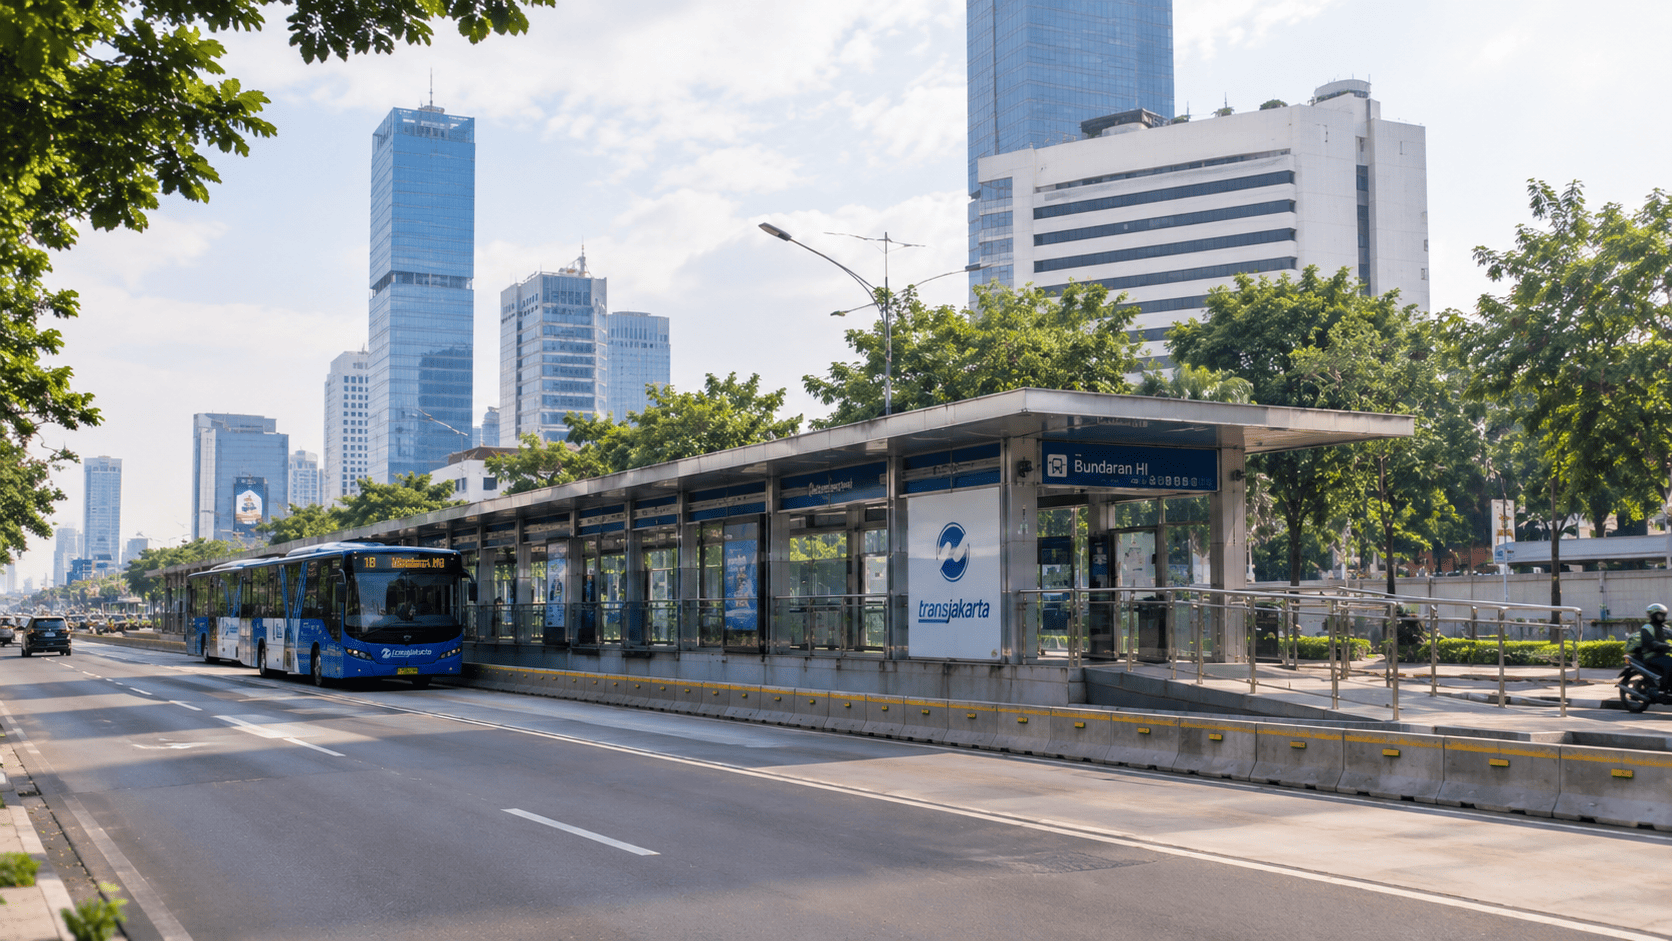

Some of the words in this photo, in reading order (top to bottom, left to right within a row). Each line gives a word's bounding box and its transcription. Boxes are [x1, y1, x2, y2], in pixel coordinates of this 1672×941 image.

[1074, 459, 1132, 475] Bundaran
[1136, 462, 1148, 476] HI
[918, 598, 990, 623] transjakarta
